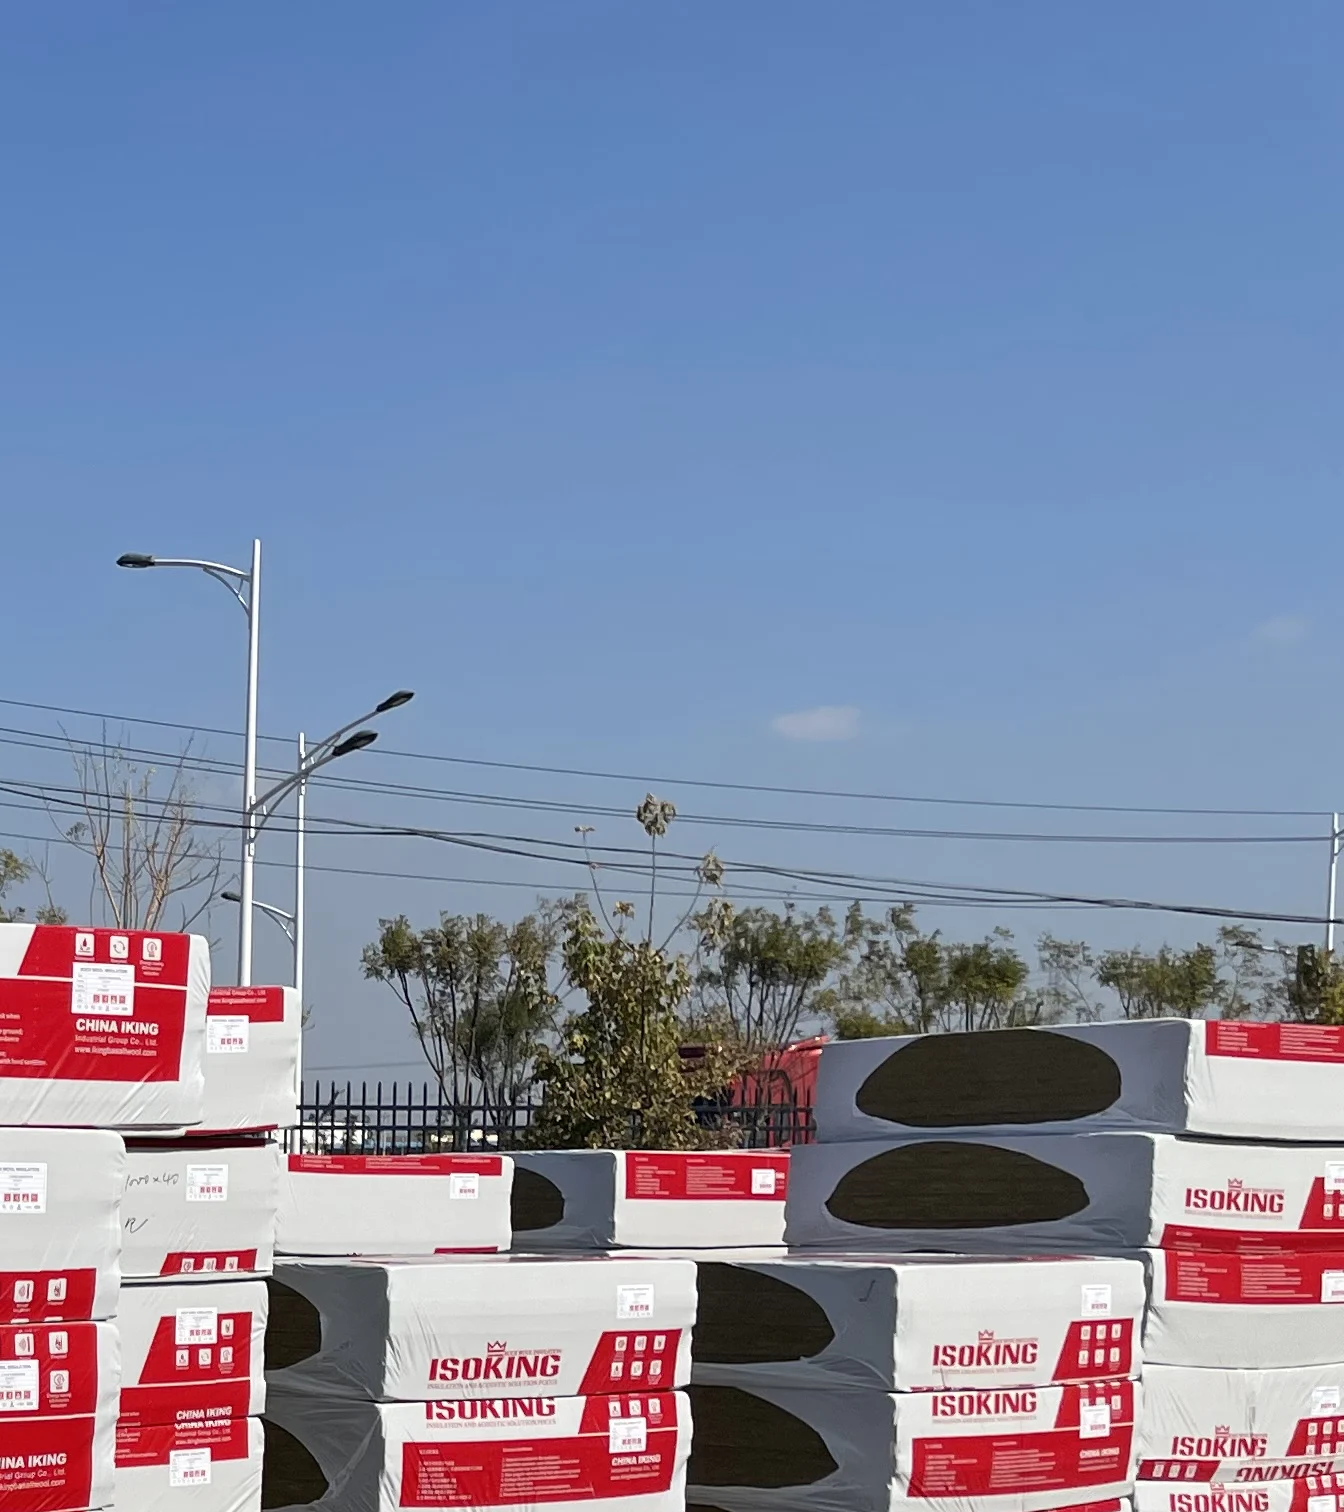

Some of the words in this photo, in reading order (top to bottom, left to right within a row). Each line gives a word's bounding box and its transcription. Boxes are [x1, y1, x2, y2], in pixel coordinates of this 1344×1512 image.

[75, 1018, 118, 1032] CHINA
[120, 1021, 158, 1035] IKING
[1185, 1187, 1284, 1213] ISOKING
[932, 1342, 1038, 1367] ISOKING
[428, 1354, 561, 1381] ISOKING
[176, 1409, 204, 1420] CHINA
[425, 1397, 555, 1420] ISOKING
[932, 1392, 1037, 1416] ISOKING
[1171, 1436, 1268, 1457] ISOKING
[27, 1453, 66, 1467] IKING
[1169, 1493, 1269, 1512] ISOKING
